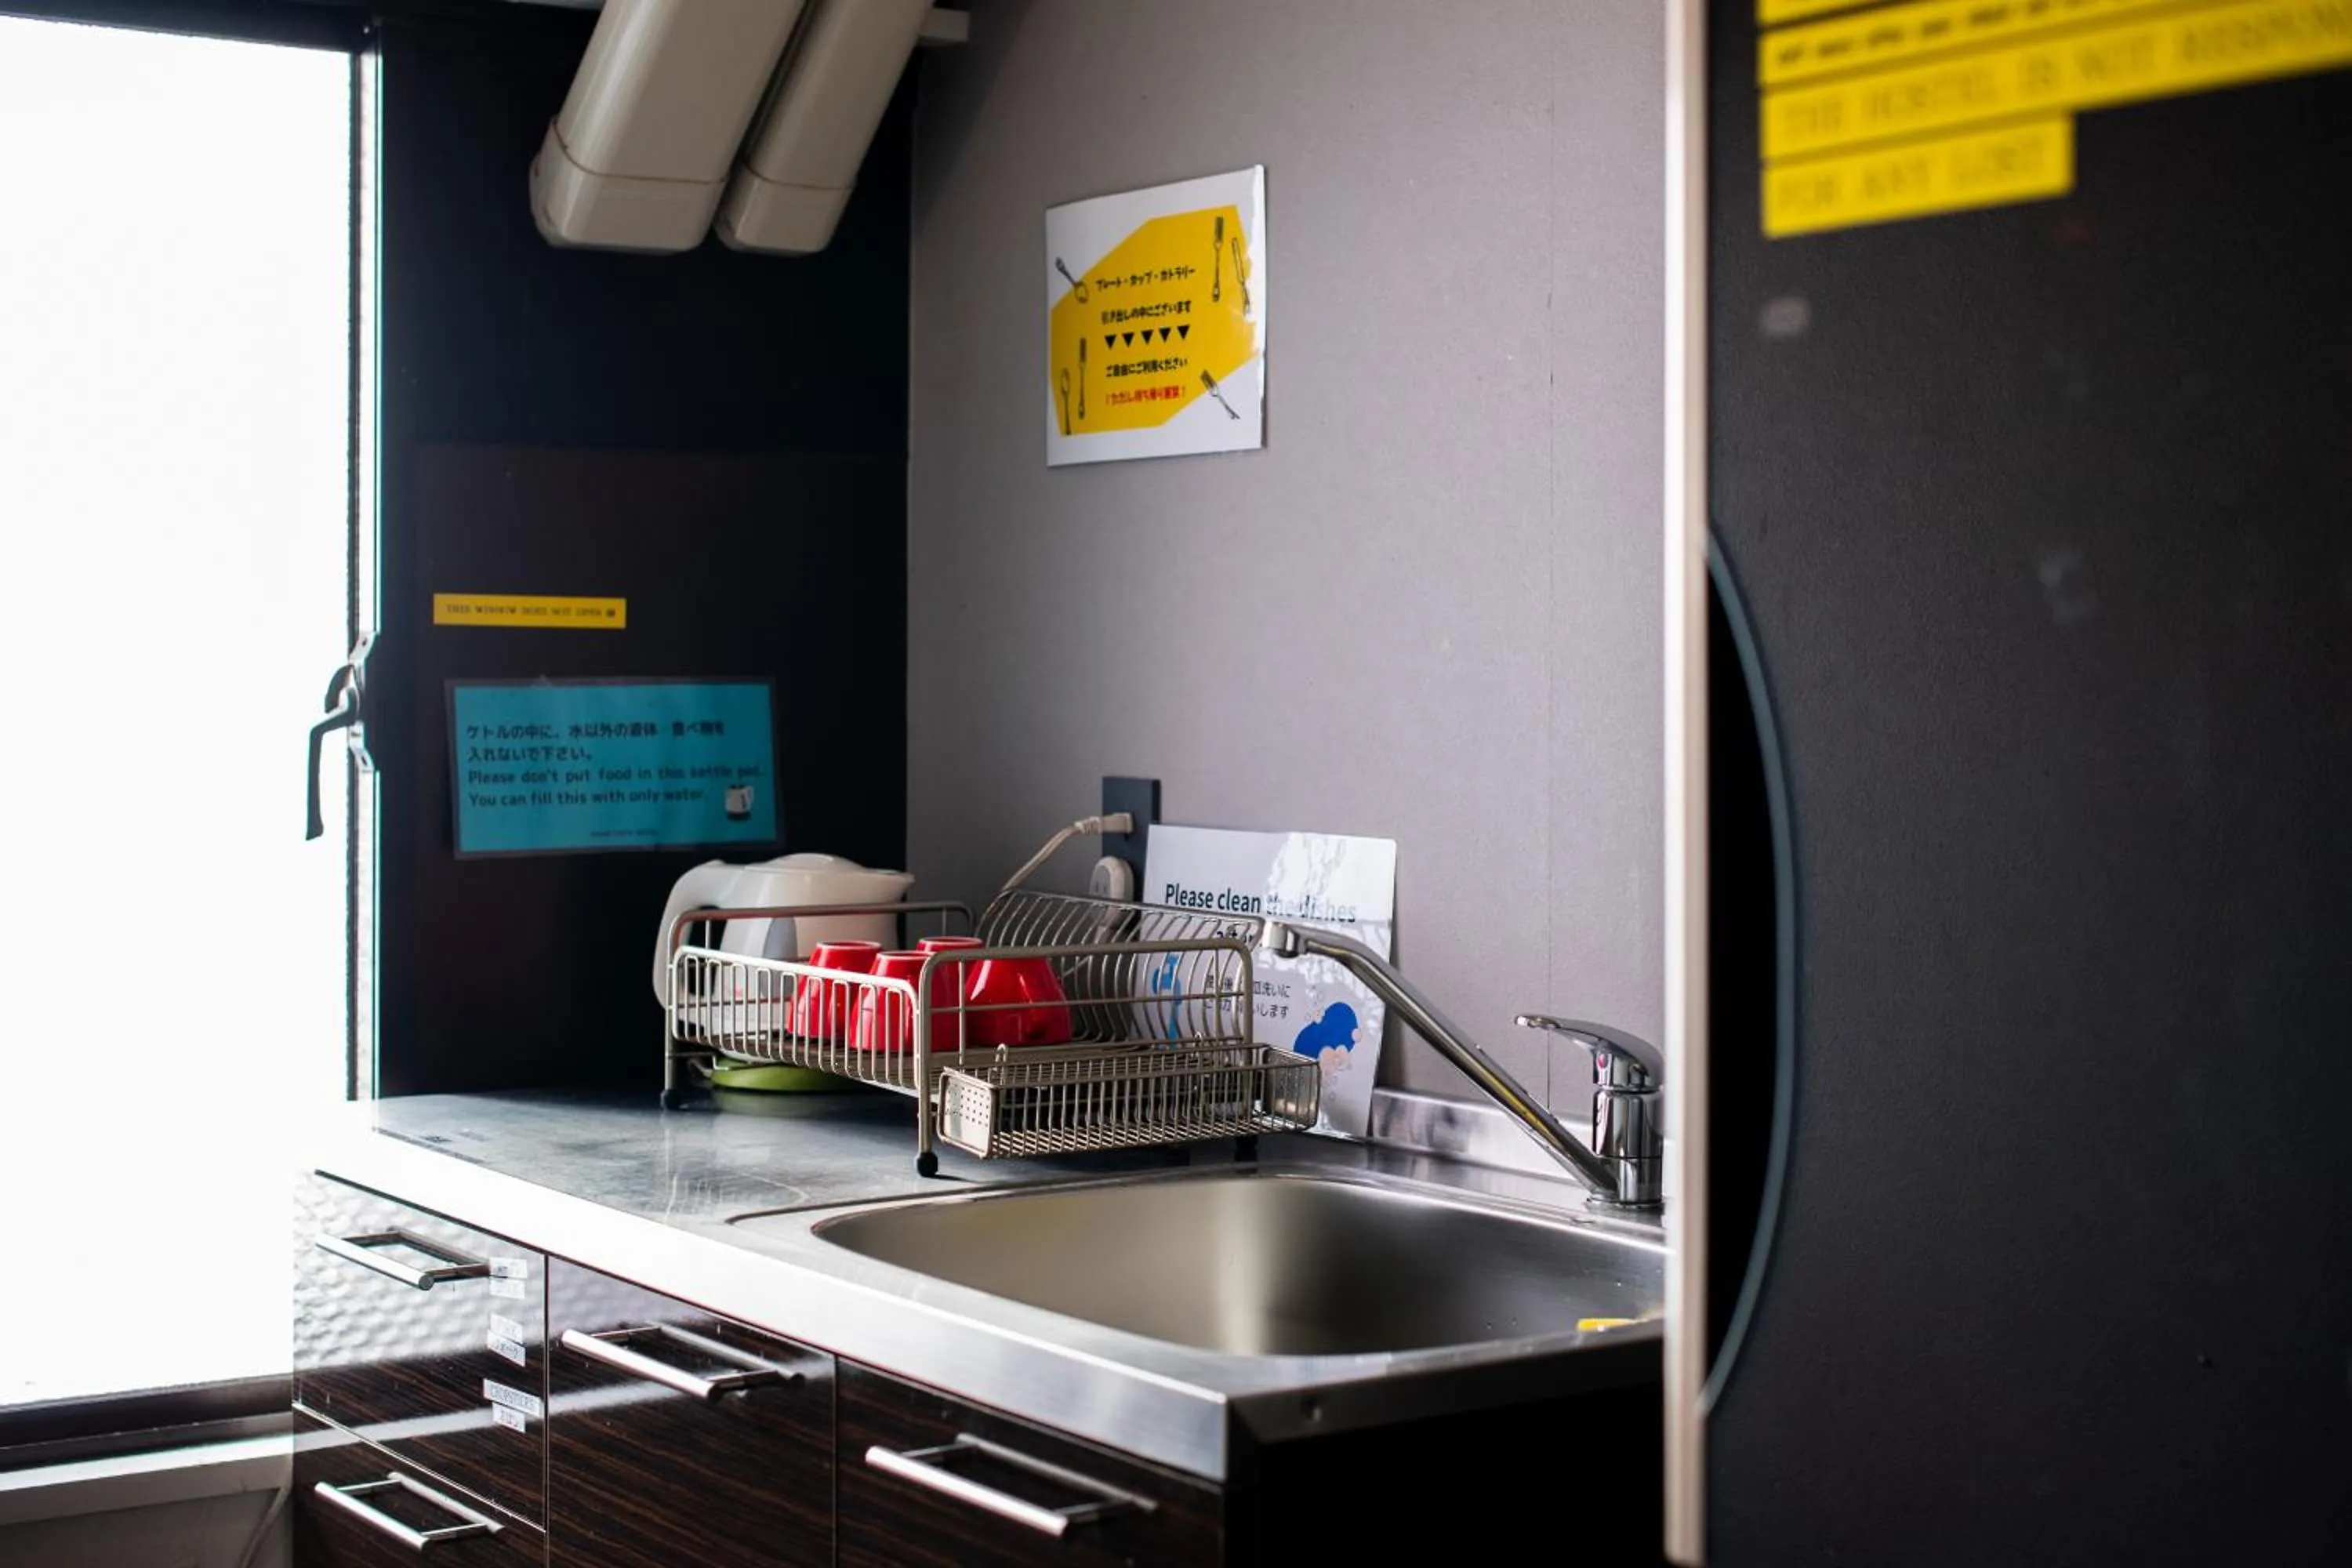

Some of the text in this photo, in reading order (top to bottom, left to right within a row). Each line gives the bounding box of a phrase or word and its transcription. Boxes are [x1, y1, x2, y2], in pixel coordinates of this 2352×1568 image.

[469, 770, 516, 783] Please
[521, 768, 558, 783] don't
[565, 768, 590, 783] put
[599, 766, 632, 781] food
[637, 767, 652, 779] in
[659, 765, 685, 779] this
[470, 792, 496, 807] You
[501, 794, 526, 806] can
[531, 789, 553, 806] fill
[557, 789, 586, 804] this
[592, 788, 626, 804] with
[630, 787, 659, 804] only
[1165, 883, 1214, 909] Please
[1217, 887, 1261, 913] clean
[1298, 895, 1356, 924] dishes
